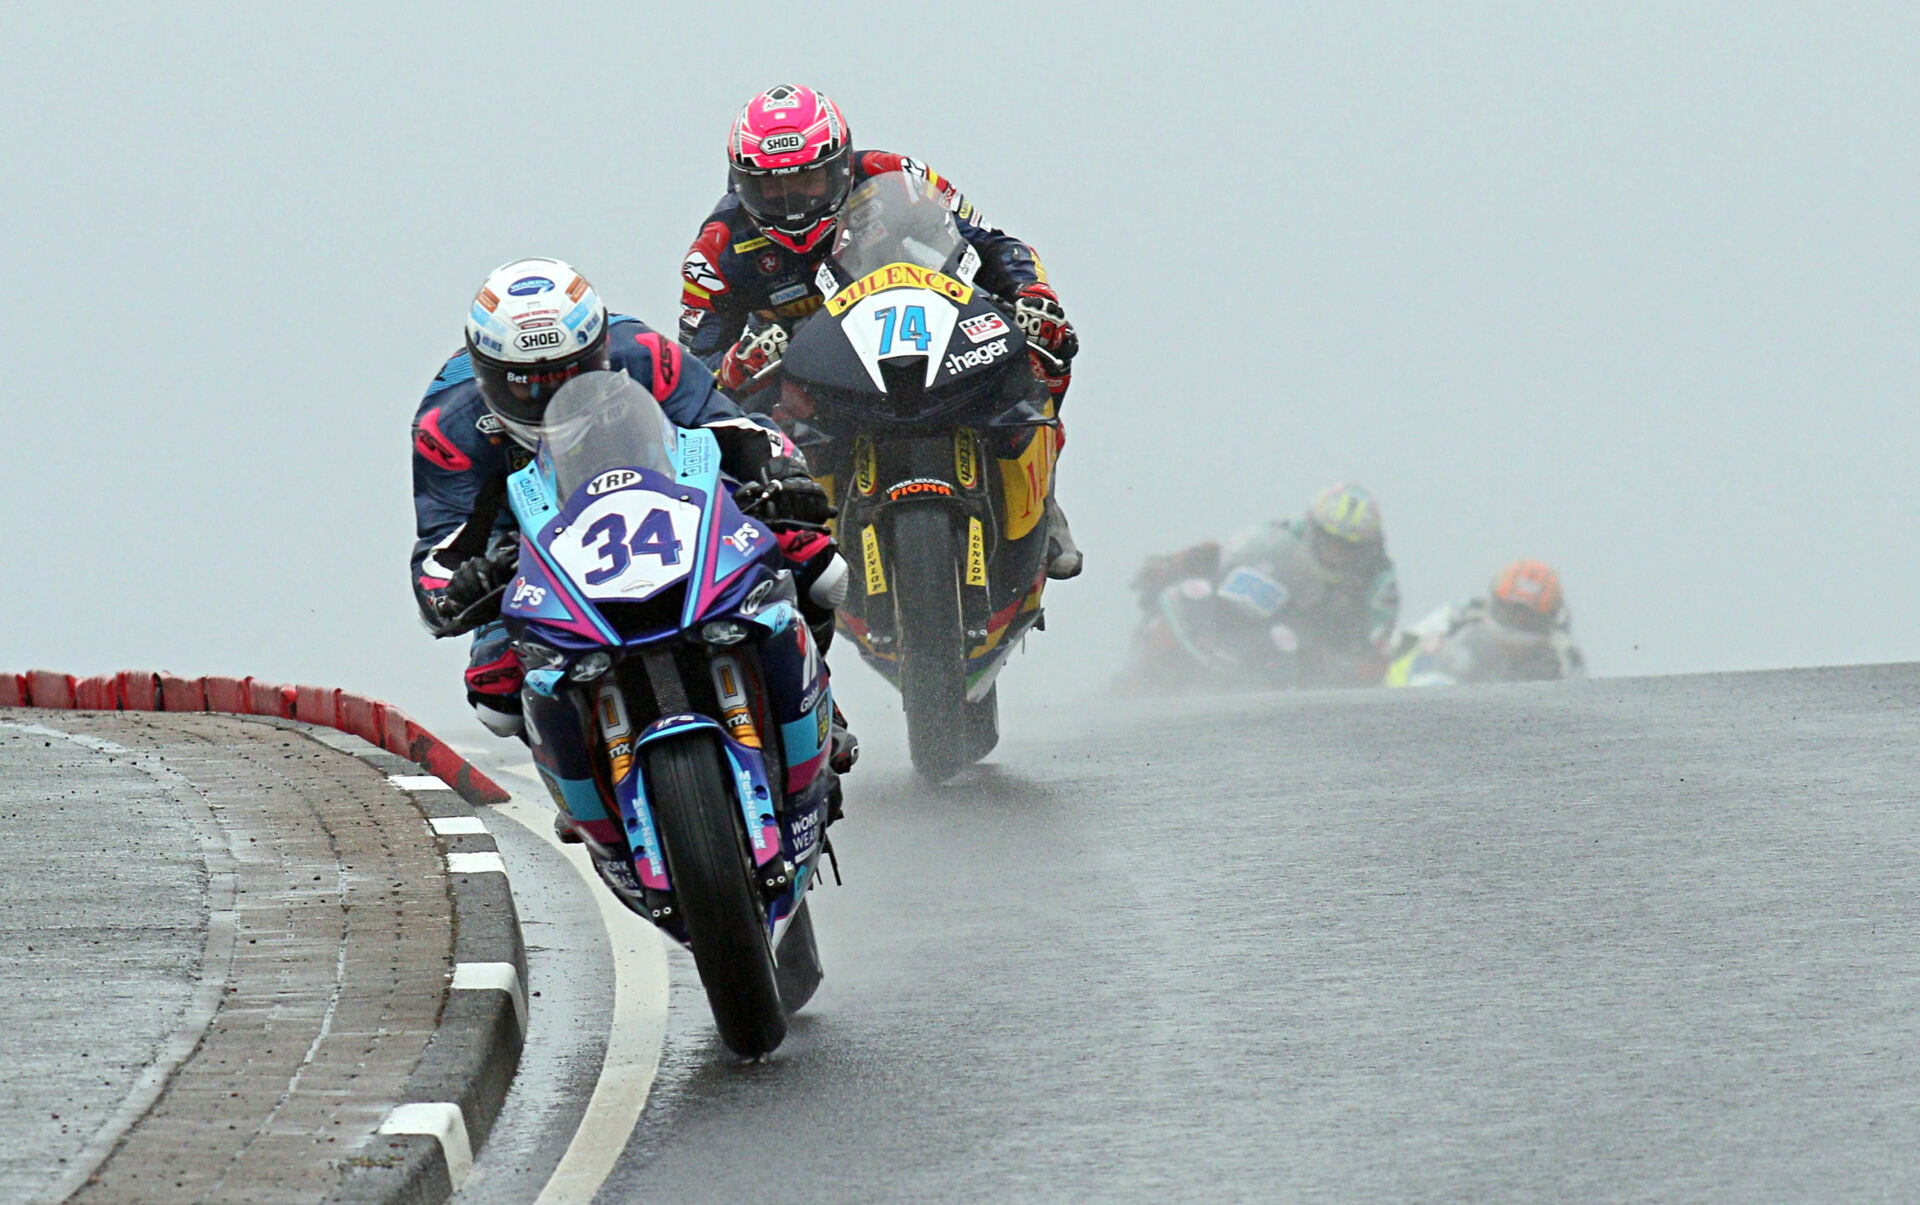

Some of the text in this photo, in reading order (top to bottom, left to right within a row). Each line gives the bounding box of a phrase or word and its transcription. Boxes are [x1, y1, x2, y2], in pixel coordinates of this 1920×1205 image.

[766, 135, 799, 150] SHOEI
[835, 265, 964, 313] MILENCO
[520, 331, 560, 348] SHOEI
[874, 305, 932, 356] 74
[592, 471, 635, 493] YRP
[890, 482, 951, 501] FIONA
[581, 508, 683, 586] 34
[970, 534, 982, 582] DUNLOP
[866, 541, 882, 592] DUNLOP
[726, 712, 751, 728] TTX
[608, 742, 634, 759] TTX
[738, 770, 768, 850] METZELER
[791, 809, 819, 835] WORK
